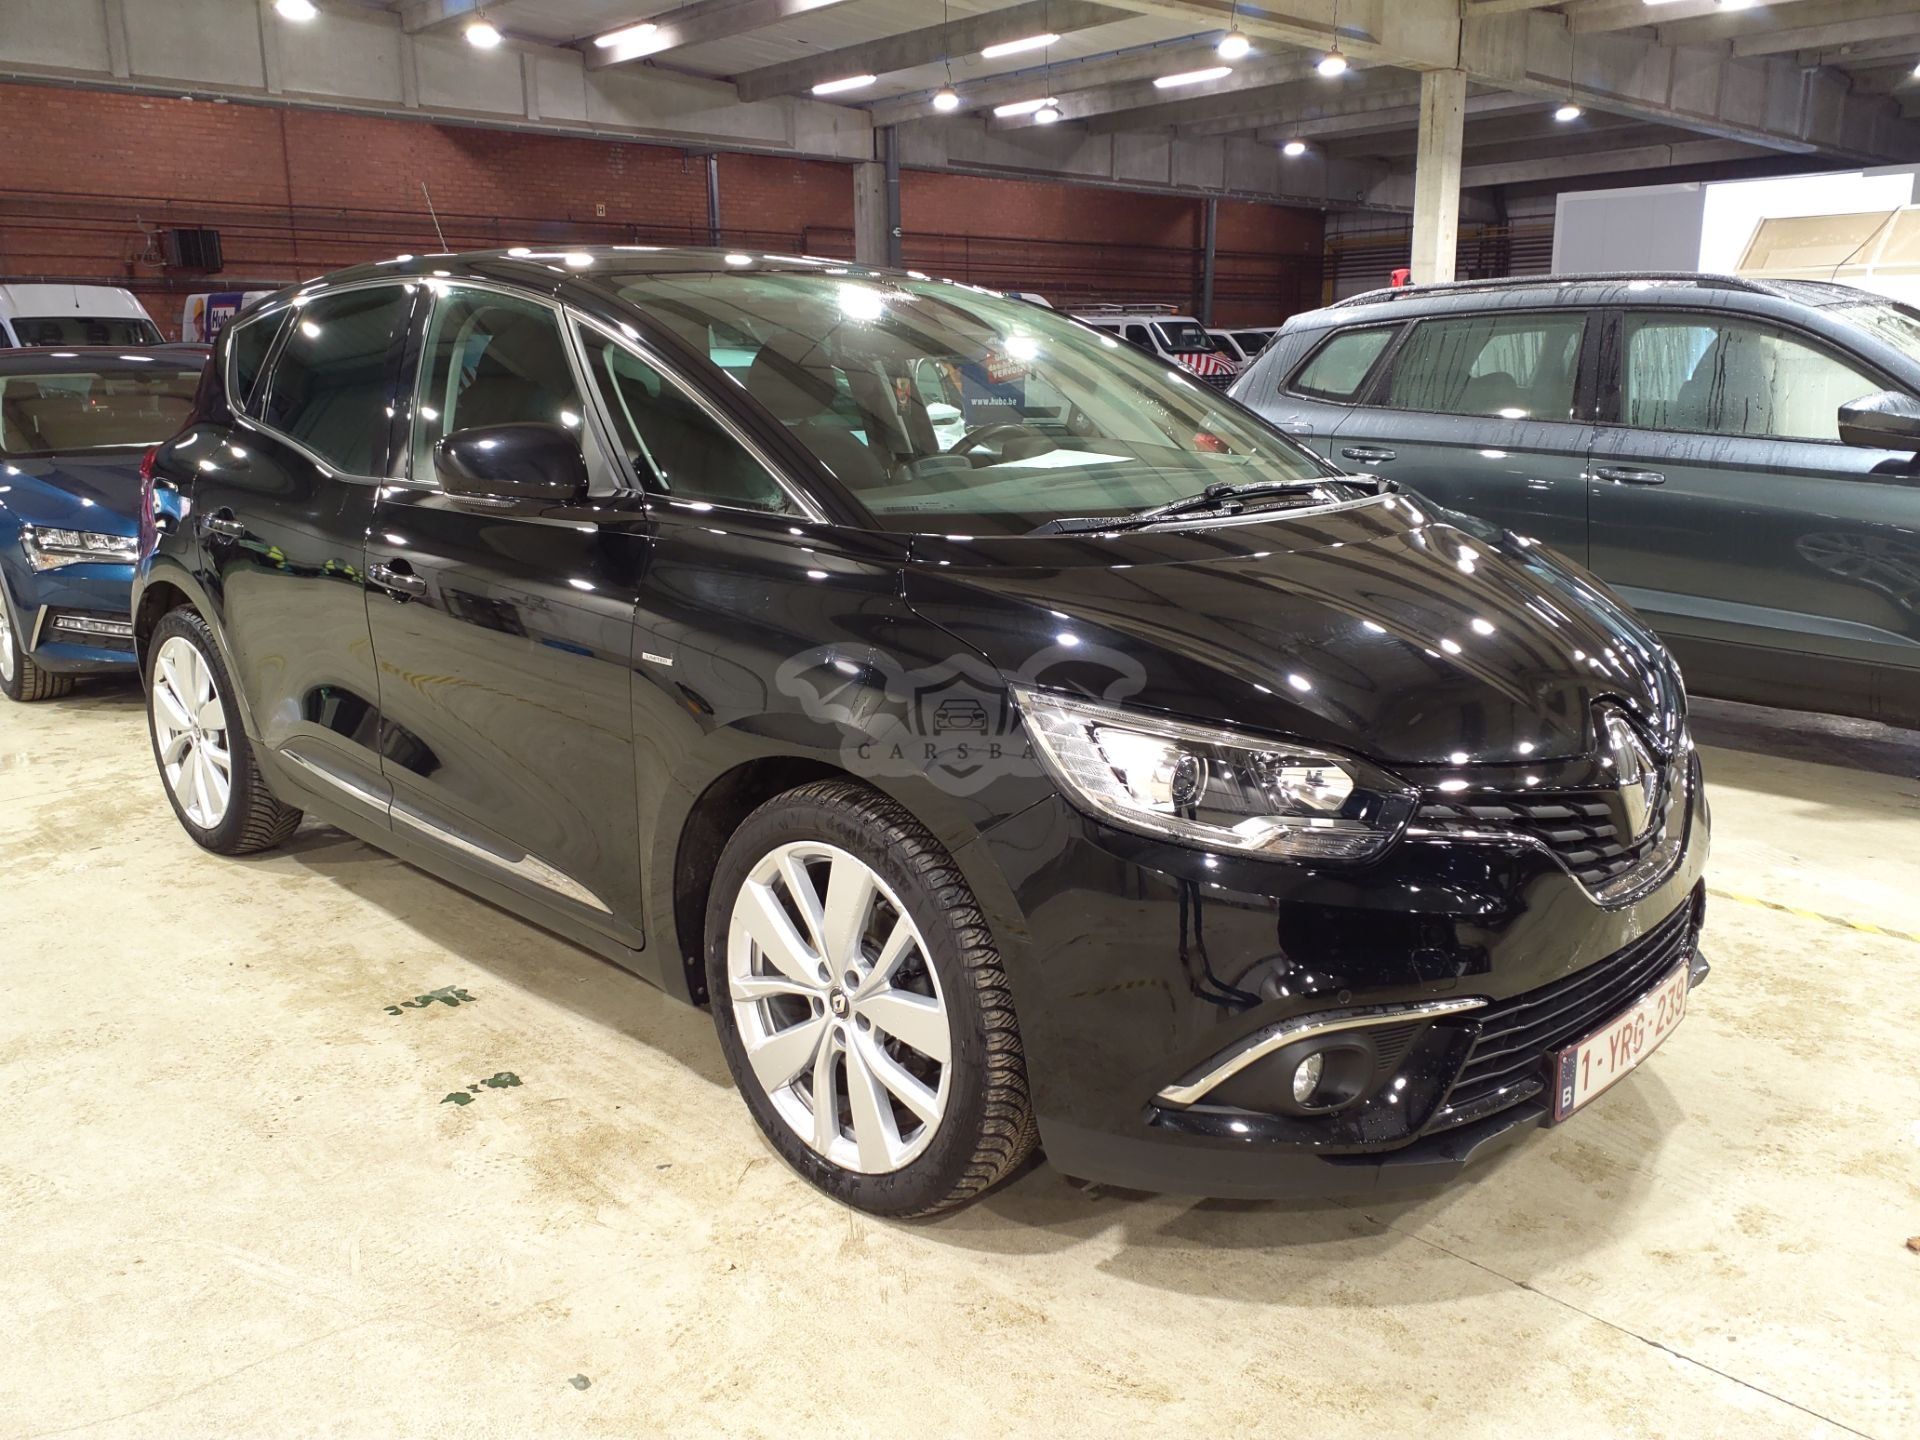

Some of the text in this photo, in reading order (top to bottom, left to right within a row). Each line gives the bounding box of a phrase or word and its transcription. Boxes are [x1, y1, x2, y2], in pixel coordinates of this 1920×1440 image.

[212, 310, 233, 328] Hub
[1562, 976, 1685, 1108] B 1-YRG-239
